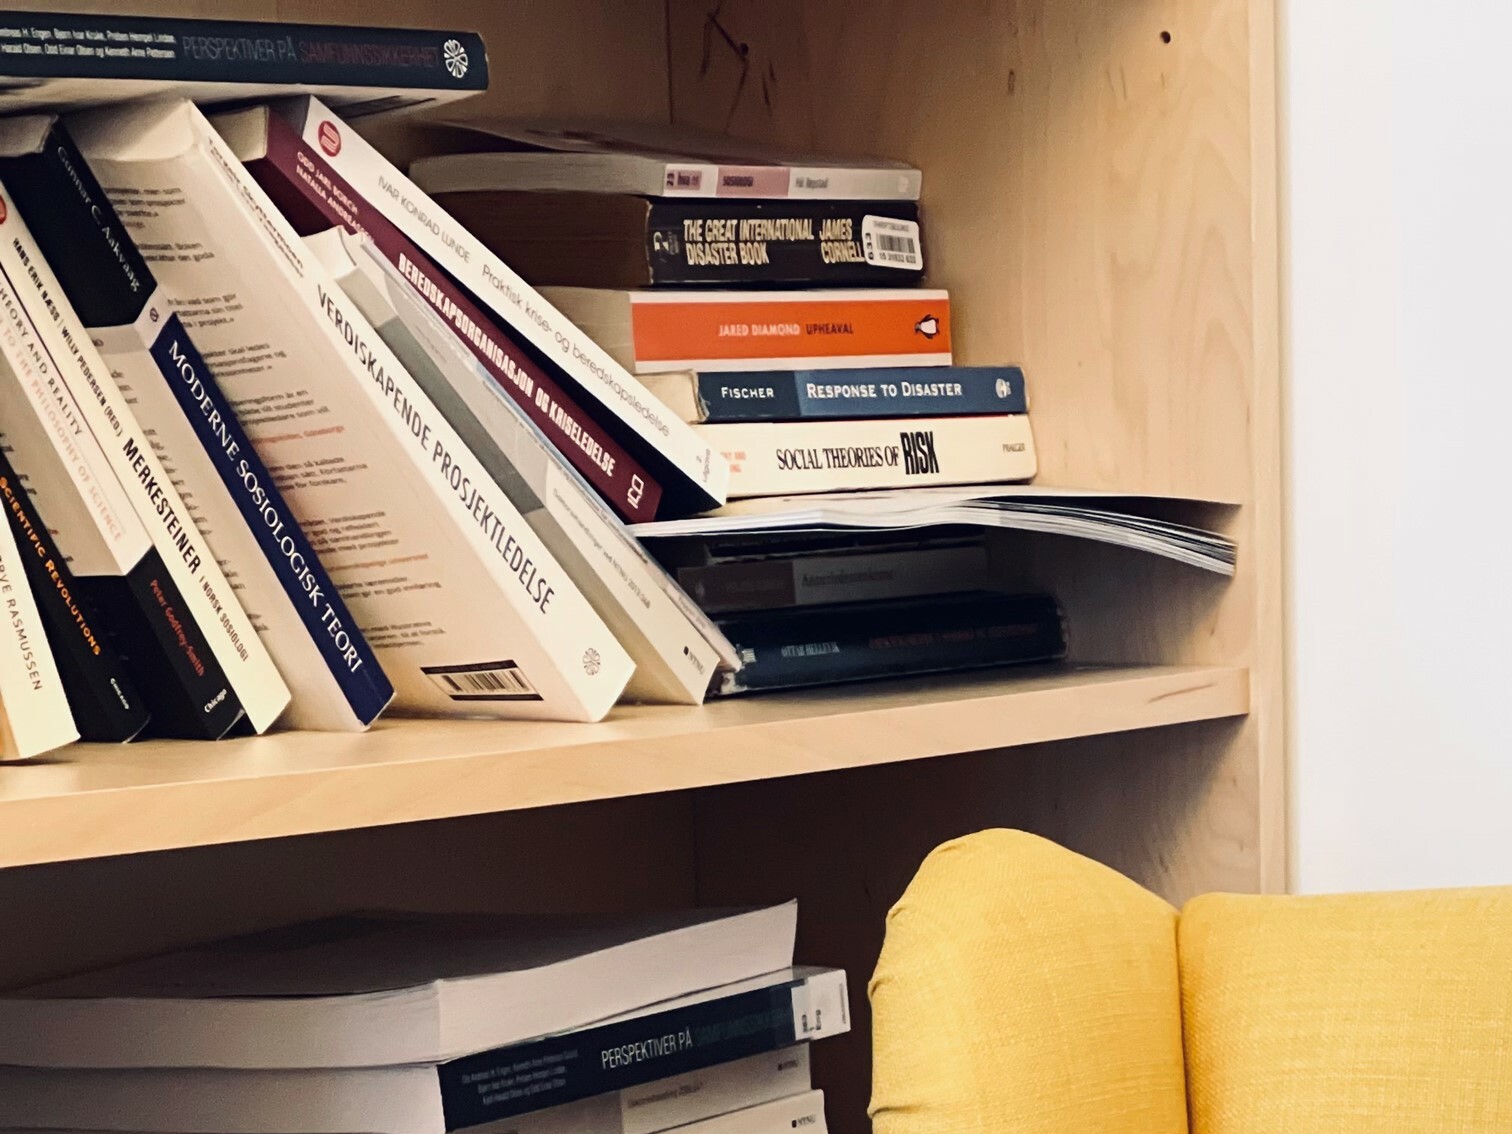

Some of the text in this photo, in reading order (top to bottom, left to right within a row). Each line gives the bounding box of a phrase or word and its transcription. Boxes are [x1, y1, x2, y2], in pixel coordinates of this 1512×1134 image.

[182, 36, 275, 61] PERSPEKTIVER
[278, 36, 297, 61] PÅ
[296, 165, 327, 200] NATALIA
[297, 152, 315, 173] ODD
[58, 147, 91, 203] Gunnar
[102, 226, 140, 292] Aakvaag
[378, 176, 471, 264] IVAR KONRAD LUNDE
[684, 219, 814, 241] THE GREAT INTERNATIONAL
[820, 219, 852, 240] JAMES
[821, 242, 865, 263] CORNELL
[686, 243, 738, 265] DISASTER
[740, 242, 769, 264] BOOK
[12, 237, 30, 267] HANS
[27, 264, 43, 290] ERIK
[41, 289, 60, 322] NÆSS
[61, 325, 79, 354] WILLY
[77, 355, 107, 407] PEDERSEN
[482, 264, 670, 437] Praktisk krise- og beredskapsledelse
[719, 324, 800, 336] JARED DIAMOND
[806, 324, 853, 335] UPHEAVAL
[0, 283, 82, 435] HEORY AND REALITY
[398, 252, 534, 397] BEREDSKAPSORGANISASJON
[535, 387, 550, 414] OG
[549, 401, 616, 477] KRISELEDELSE
[807, 383, 876, 398] RESPONSE
[902, 382, 962, 396] DISASTER
[721, 387, 774, 398] FISCHER
[15, 349, 32, 378] THE
[30, 379, 81, 463] PHILOSOPHY
[78, 465, 92, 483] OF
[89, 485, 122, 542] SCIENCE
[317, 284, 431, 451] VERDISKAPENDE
[432, 440, 555, 615] PROSJEKTLEDELSE
[777, 431, 939, 475] SOCIAL THEORIES OF RISK
[168, 340, 240, 462] MODERNE
[236, 459, 325, 608] SOSIOLOGISK
[320, 603, 364, 674] TEORI
[0, 476, 101, 655] SCIENTIFIC REVOLUTIONS
[123, 437, 201, 575] MERKESTEINER
[202, 581, 223, 615] NORSK
[219, 613, 249, 661] SOSIOLOGI
[6, 598, 43, 691] RASMUSSEN
[150, 579, 205, 677] Peter Godfrey-Smith
[601, 1035, 677, 1069] PERSPEKTIVER
[678, 1026, 693, 1050] PÅ
